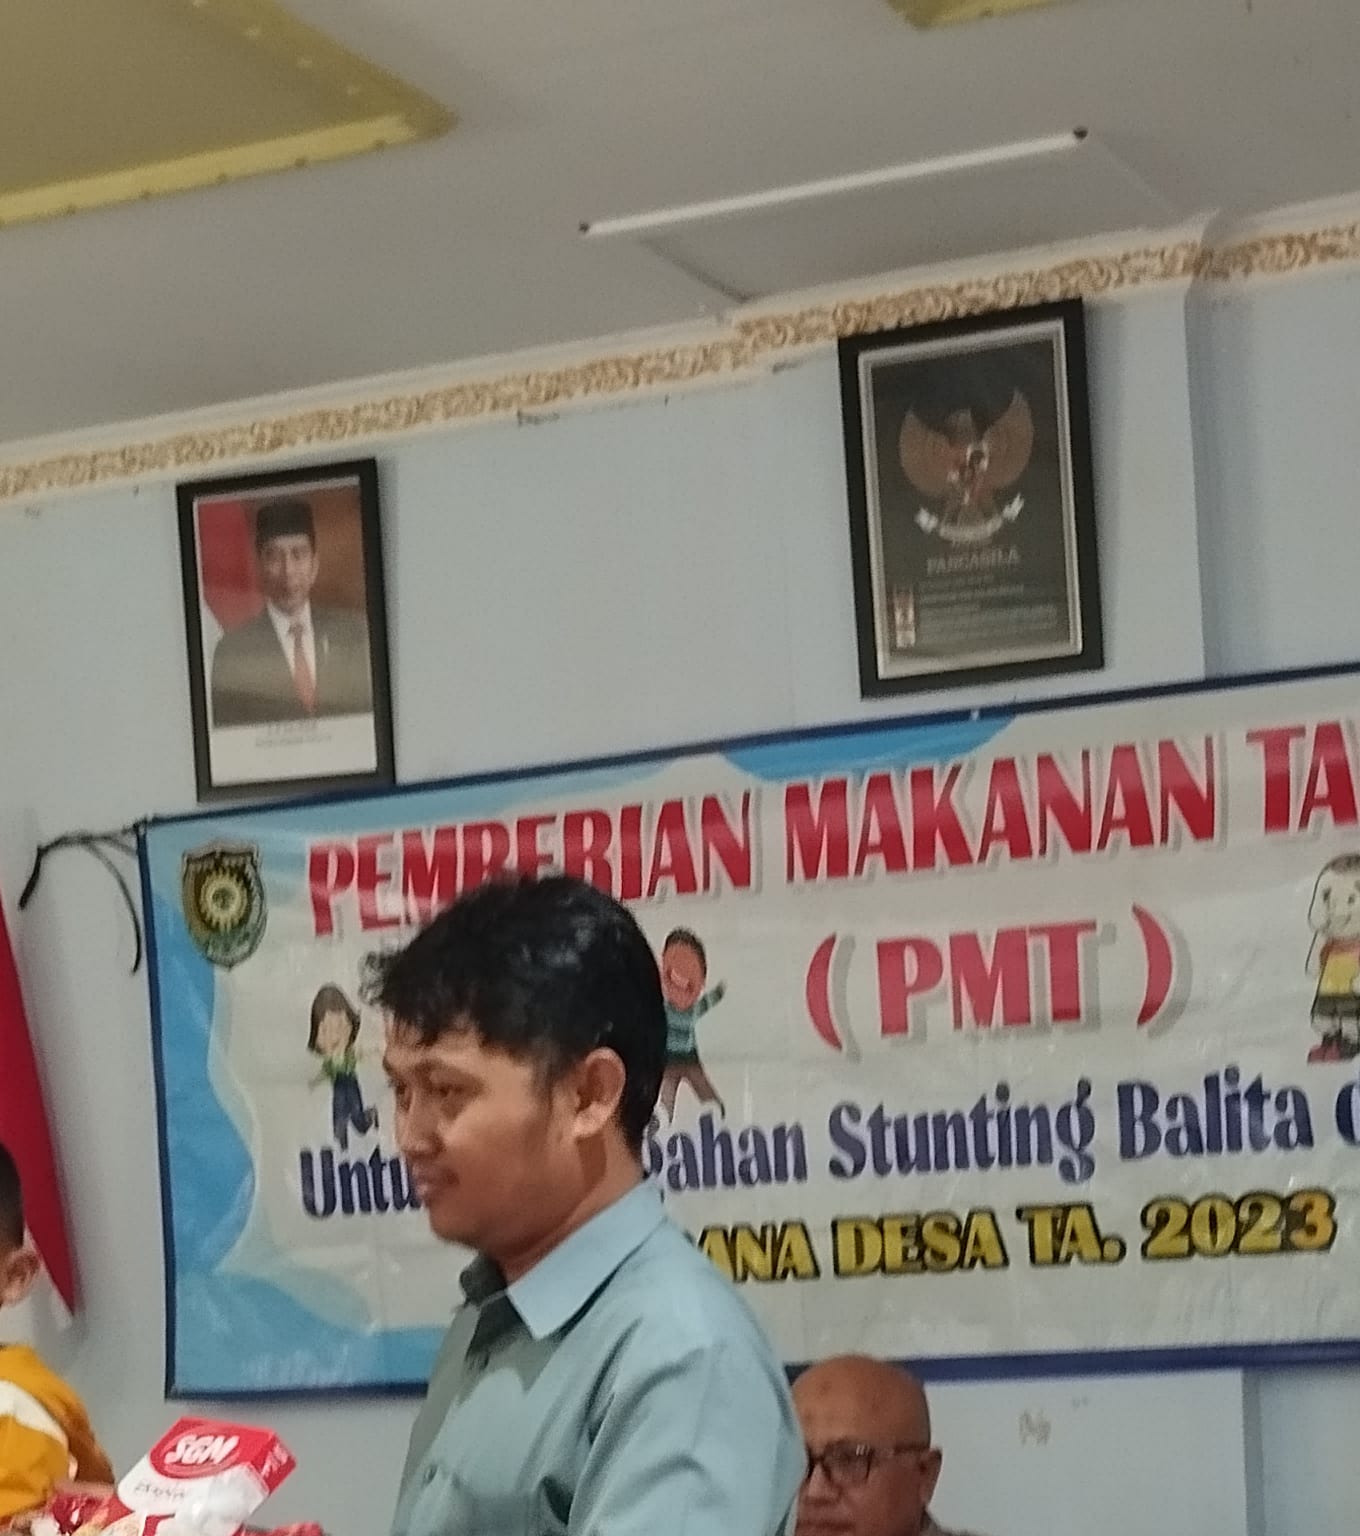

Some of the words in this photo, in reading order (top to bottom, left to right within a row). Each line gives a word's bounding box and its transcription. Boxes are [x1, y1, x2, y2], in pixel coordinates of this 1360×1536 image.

[785, 735, 1216, 883] MAKANAN
[300, 1145, 422, 1218] Untu
[828, 1080, 1097, 1183] Stunting
[1116, 1064, 1314, 1162] Balita
[831, 1208, 1010, 1278] DESA
[1016, 1201, 1128, 1266] TA.
[1140, 1188, 1340, 1262] 2023
[162, 1433, 241, 1465] SGM
